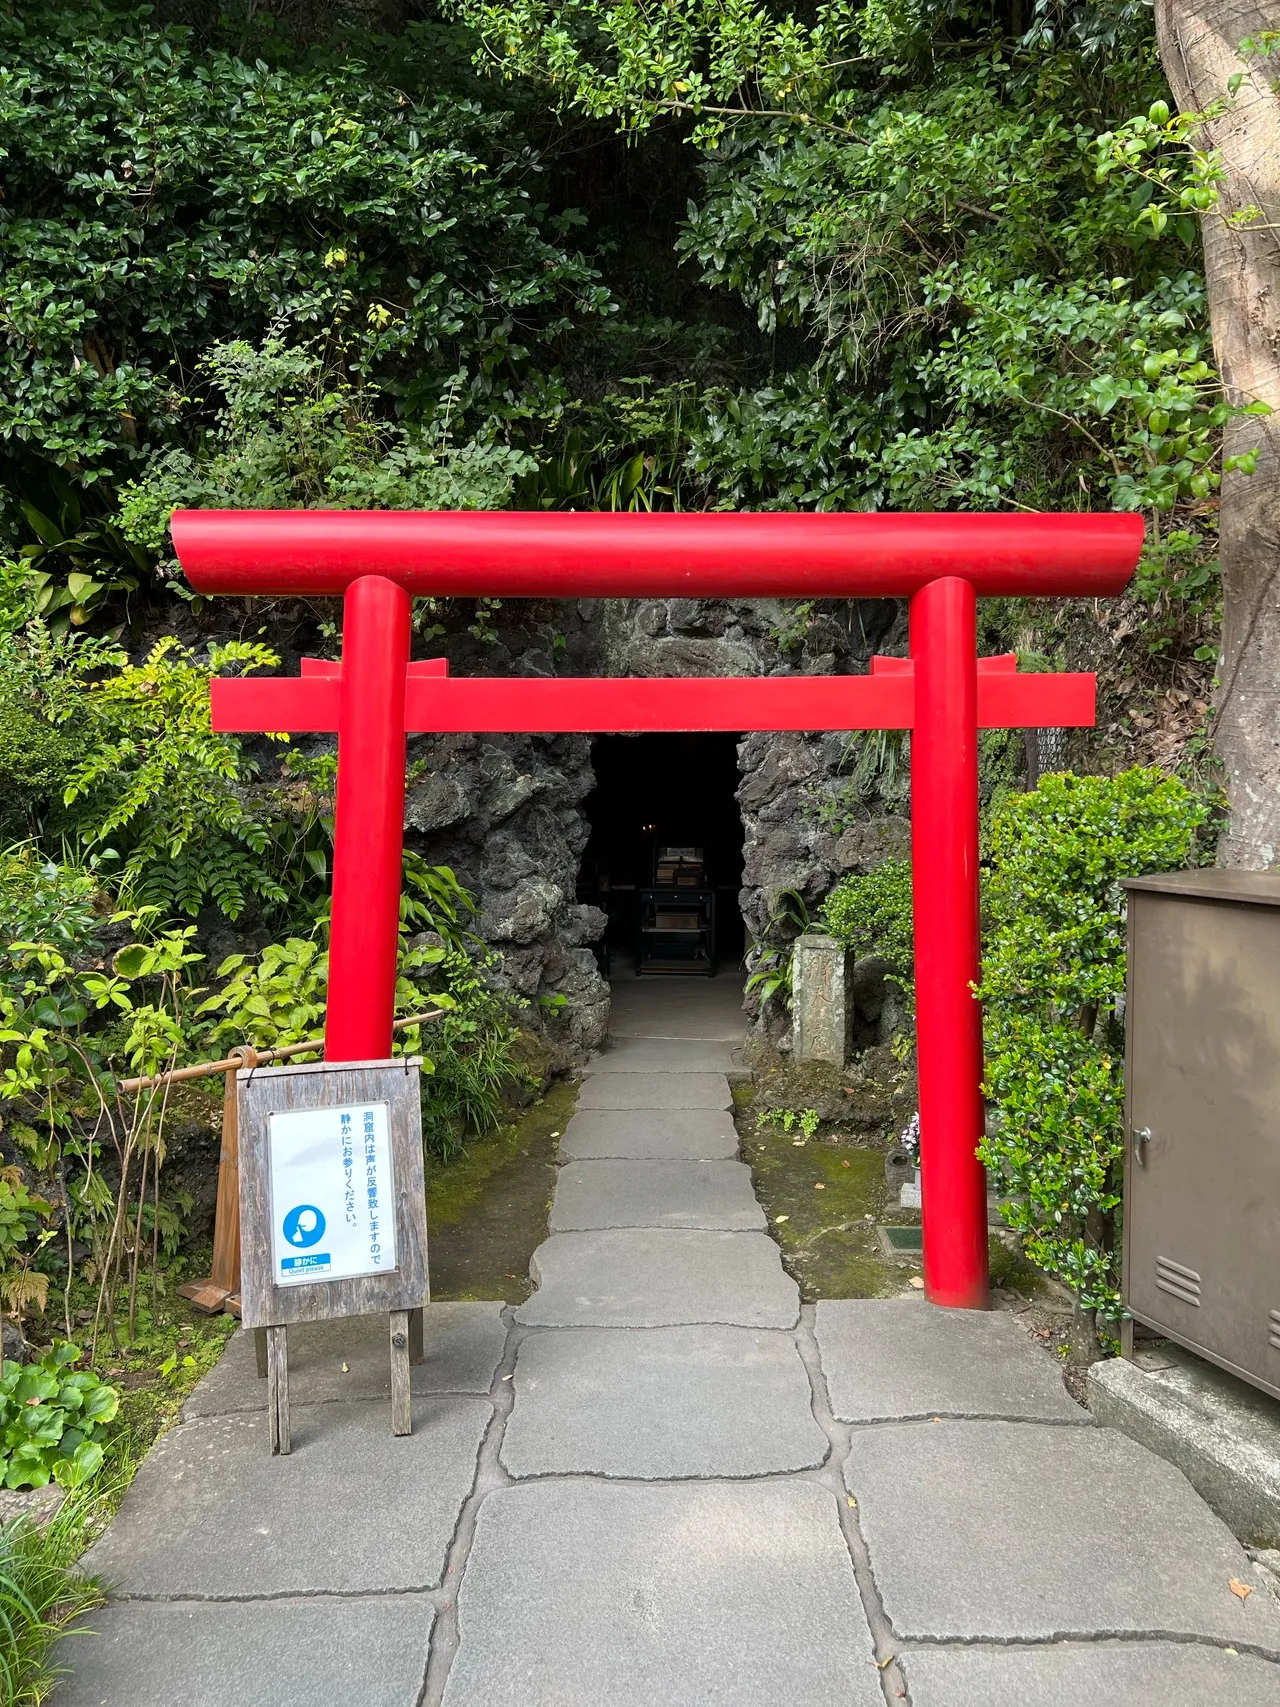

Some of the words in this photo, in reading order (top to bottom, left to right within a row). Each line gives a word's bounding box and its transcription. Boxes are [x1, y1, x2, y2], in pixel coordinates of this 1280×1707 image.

[340, 1113, 357, 1228] 静かにお参りください。
[363, 1111, 381, 1265] 洞窟内は声が反響致しますので
[288, 1266, 305, 1275] Quiet
[305, 1264, 324, 1273] please
[294, 1257, 318, 1267] 静かに
